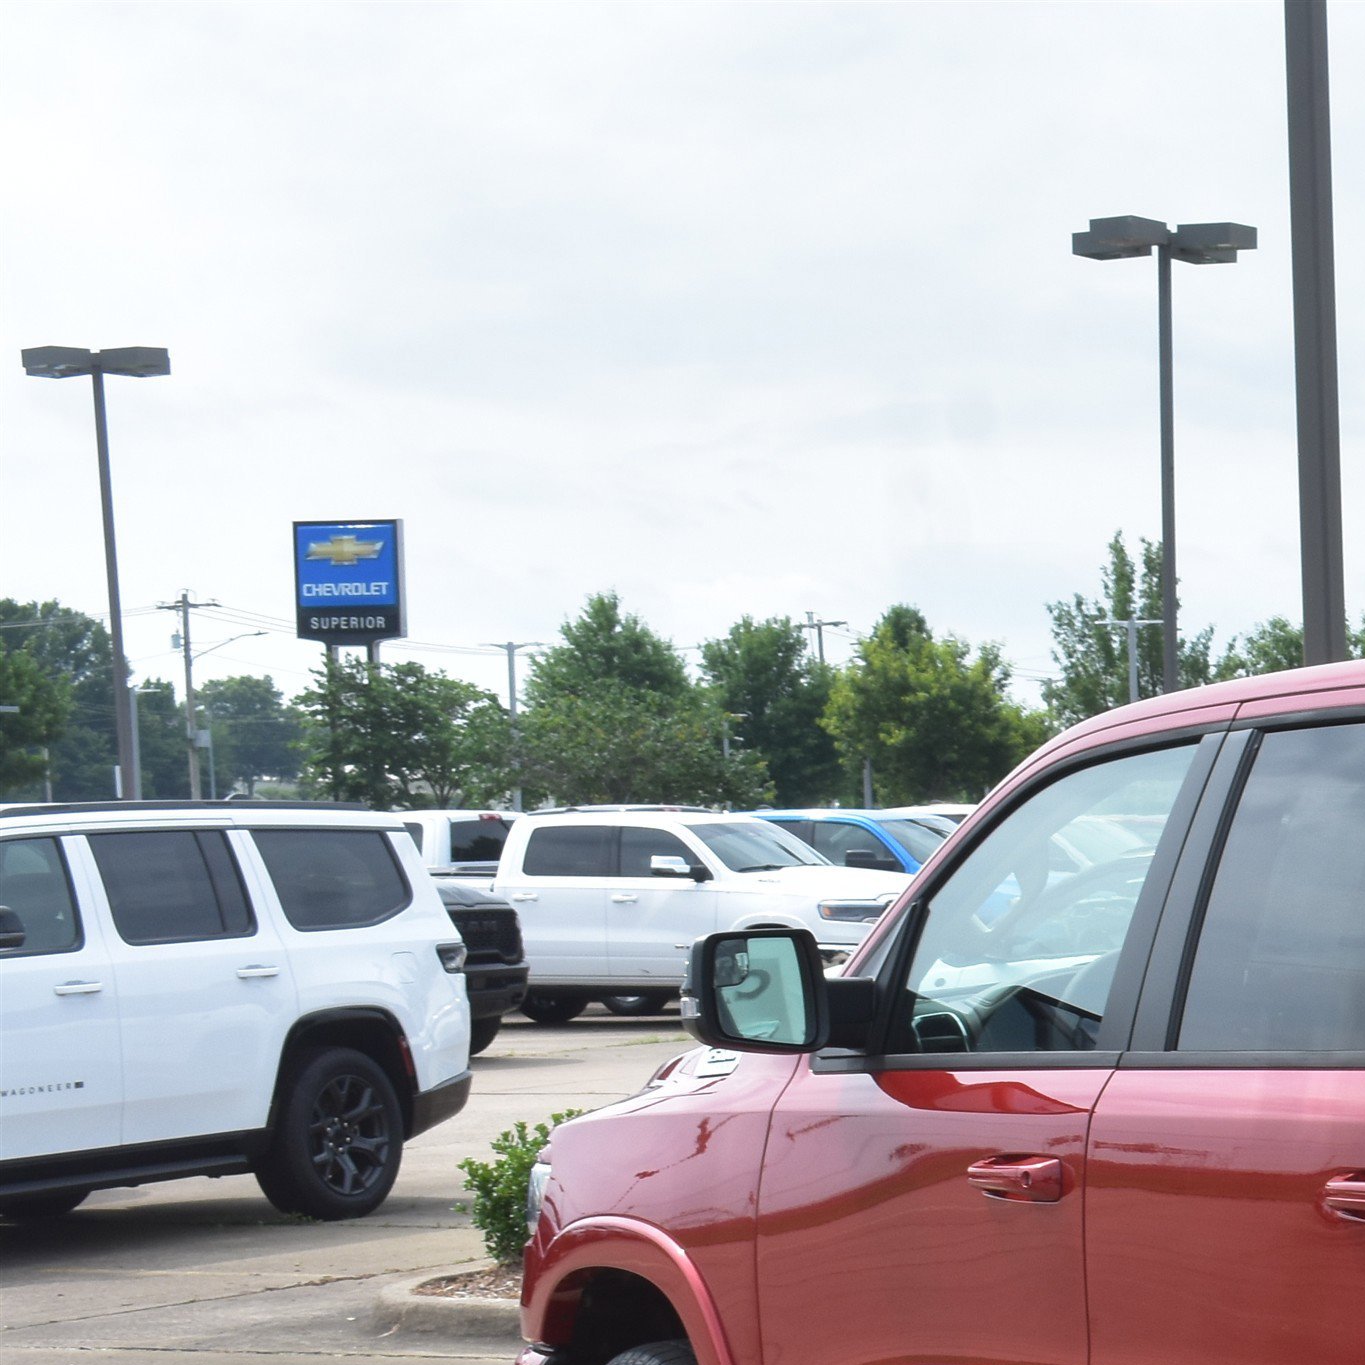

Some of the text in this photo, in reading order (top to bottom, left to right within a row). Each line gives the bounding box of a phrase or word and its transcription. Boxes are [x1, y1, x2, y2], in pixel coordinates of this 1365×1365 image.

[303, 582, 389, 597] CHEVROLET
[310, 616, 386, 629] SUPERIOR
[0, 1082, 72, 1097] WAGONEER
